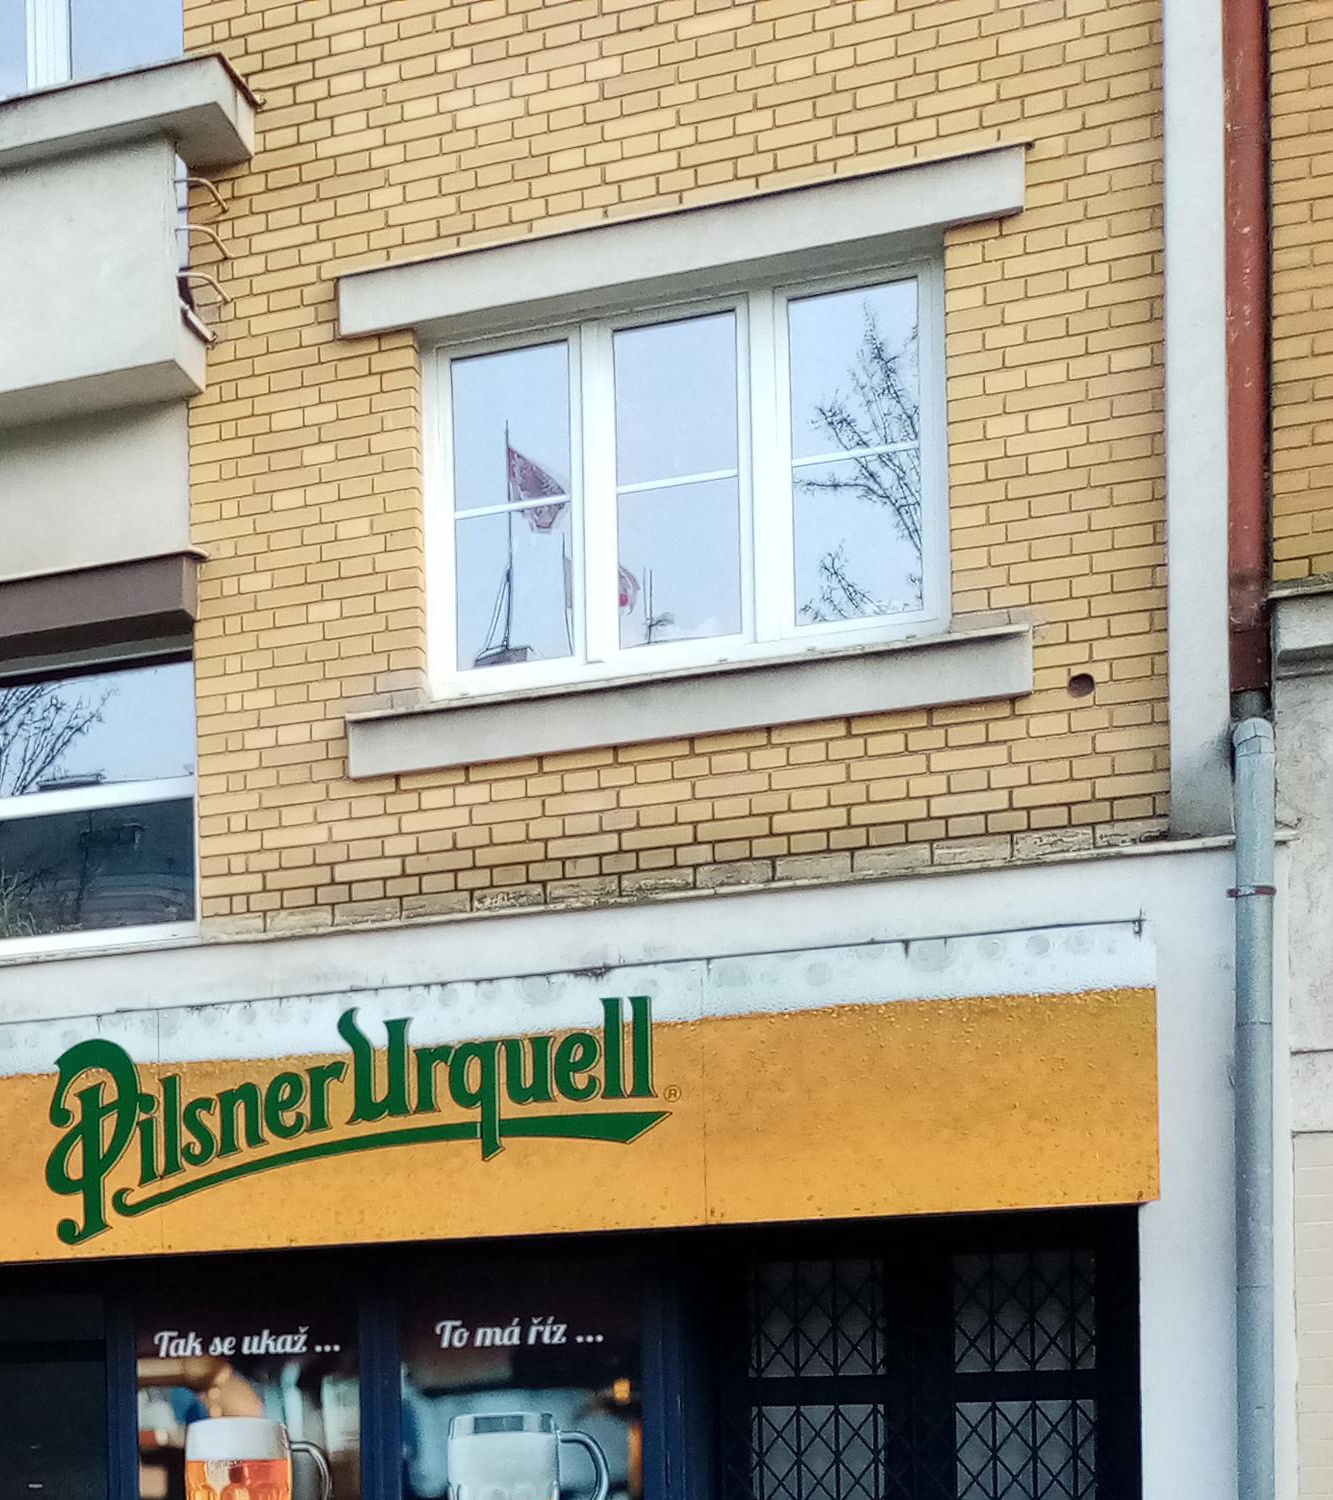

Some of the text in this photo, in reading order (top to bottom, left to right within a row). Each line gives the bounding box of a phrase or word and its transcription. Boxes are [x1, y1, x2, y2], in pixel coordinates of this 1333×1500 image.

[45, 996, 658, 1246] Pilsner Urquell
[153, 1330, 203, 1358] Tak
[208, 1337, 236, 1356] se
[240, 1326, 310, 1355] ukaž
[435, 1319, 470, 1349] To
[474, 1317, 521, 1346] má
[526, 1316, 568, 1345] říz
